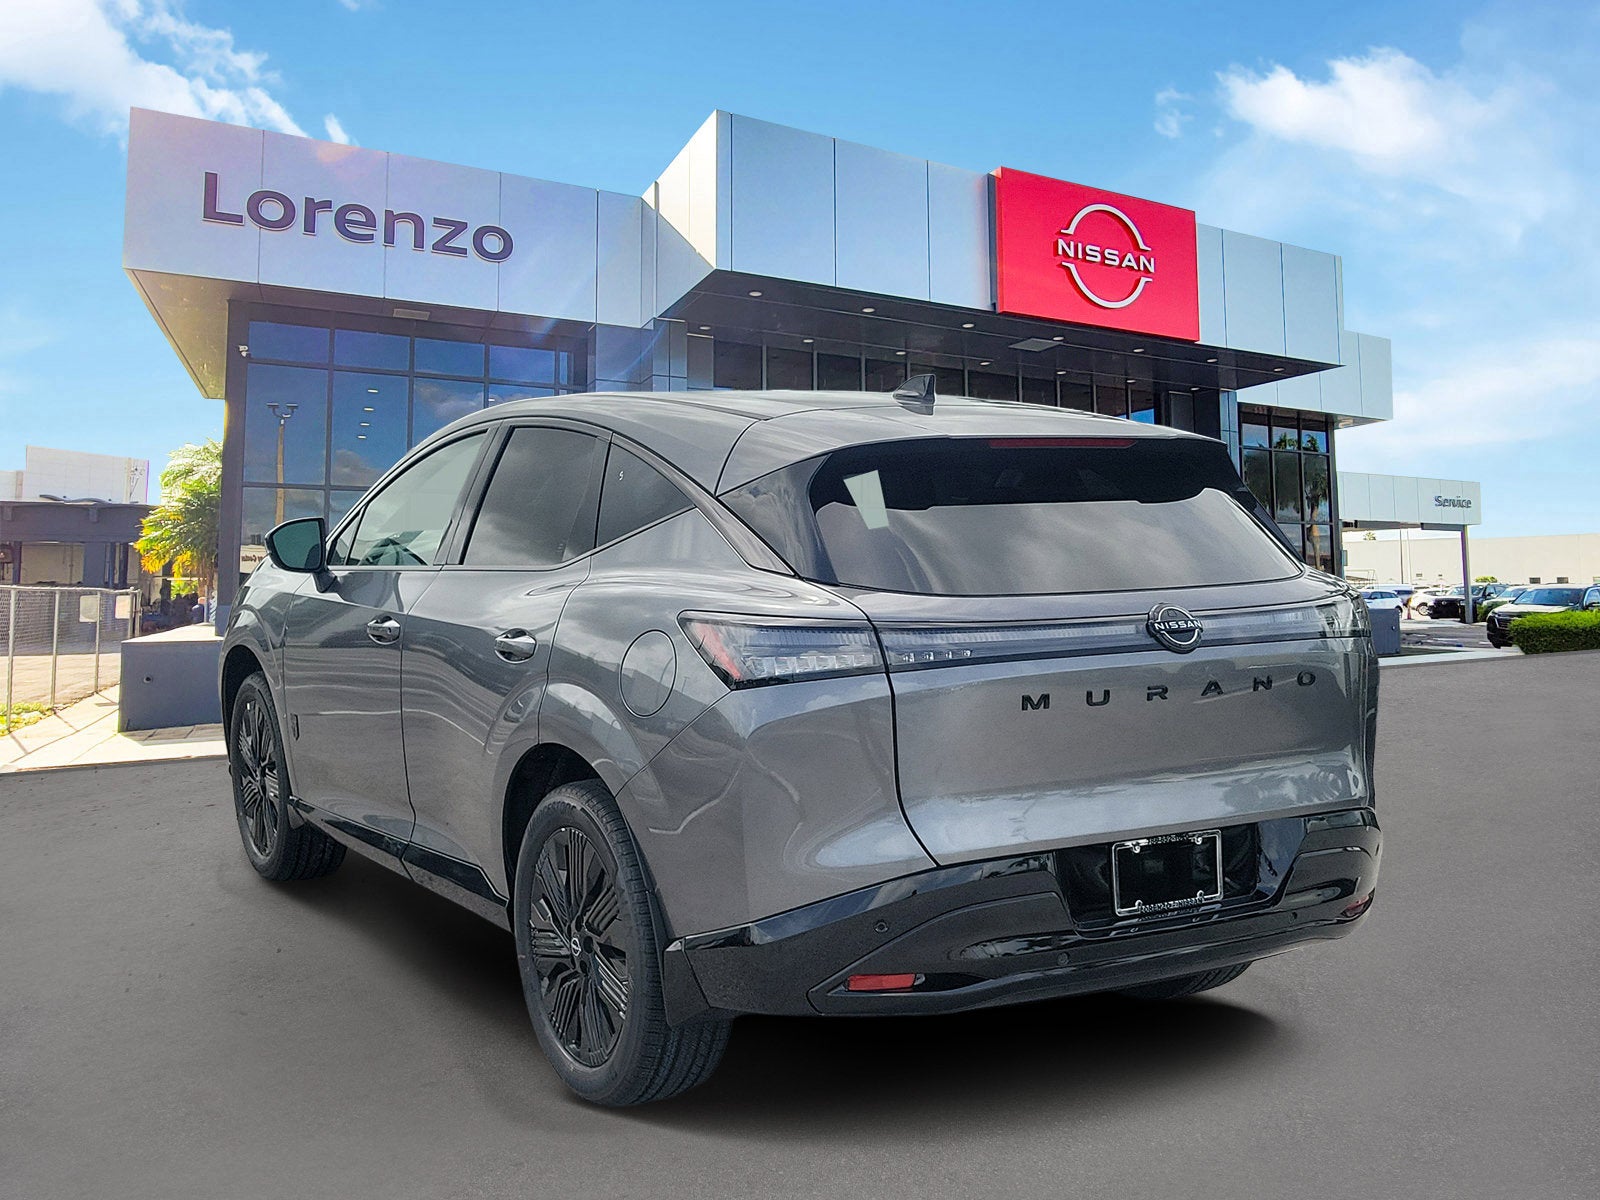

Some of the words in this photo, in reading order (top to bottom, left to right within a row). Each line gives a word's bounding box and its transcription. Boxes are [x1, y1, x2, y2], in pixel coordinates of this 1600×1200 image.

[202, 171, 515, 263] Lorenzo
[1057, 238, 1155, 273] NISSAN
[1434, 495, 1472, 509] Service
[1153, 620, 1202, 631] NISSAN
[1021, 670, 1317, 711] MURANO
